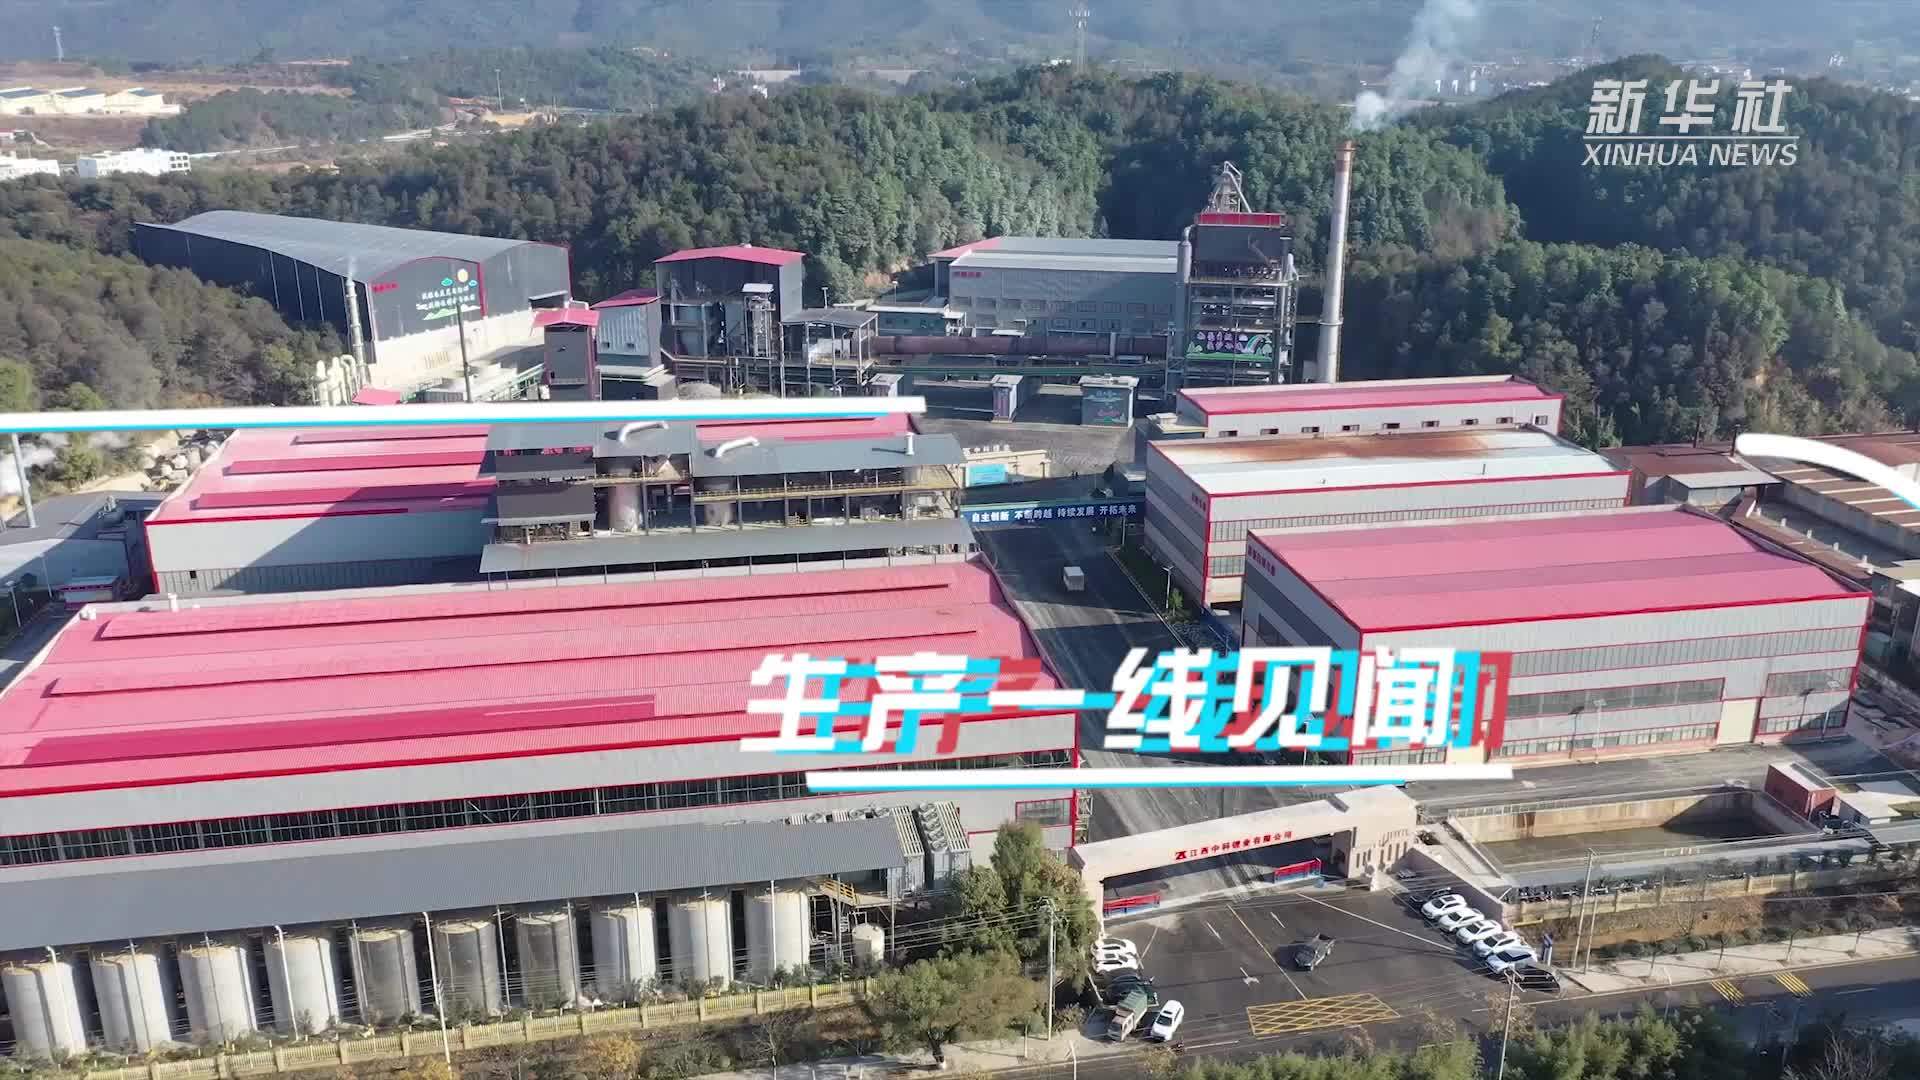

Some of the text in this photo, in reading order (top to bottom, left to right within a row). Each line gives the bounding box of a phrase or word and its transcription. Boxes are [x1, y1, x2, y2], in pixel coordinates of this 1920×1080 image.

[972, 511, 1009, 523] 自主创新
[1057, 506, 1094, 518] 持续发展
